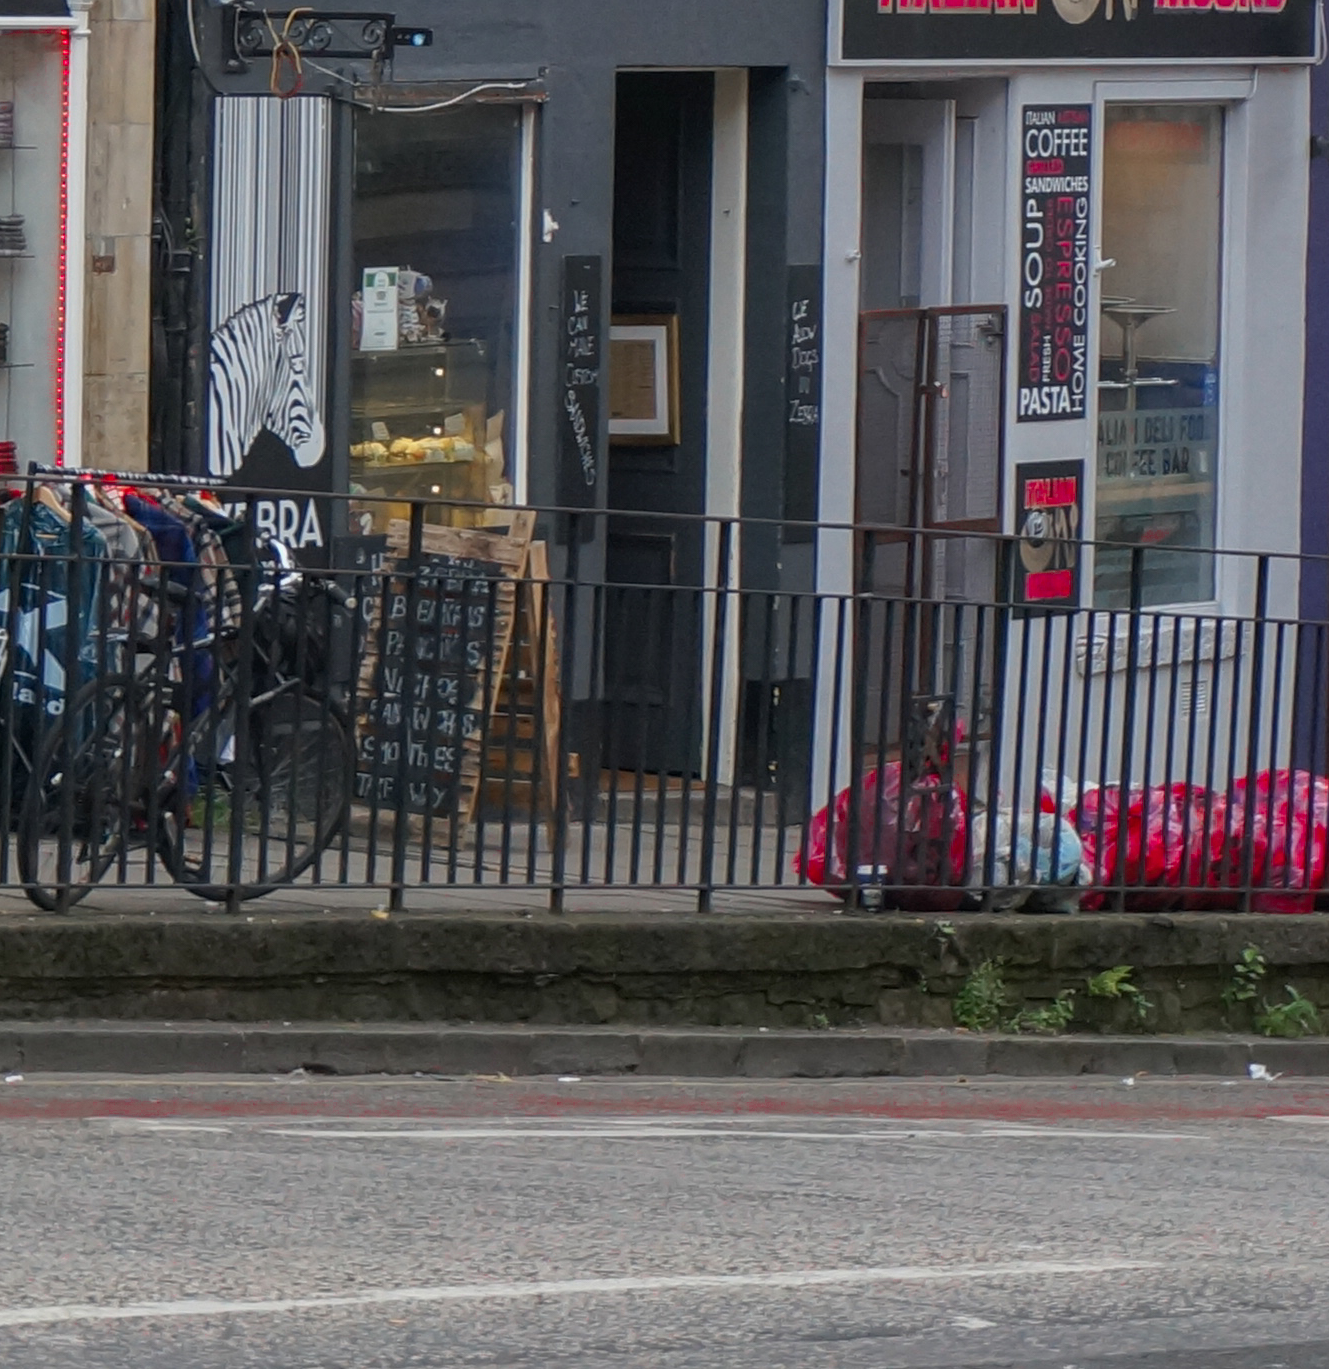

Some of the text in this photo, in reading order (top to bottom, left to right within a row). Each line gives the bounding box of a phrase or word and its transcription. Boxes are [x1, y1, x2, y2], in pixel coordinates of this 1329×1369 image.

[1025, 111, 1056, 125] ITALIAN
[1025, 128, 1088, 158] COFFEE
[1025, 176, 1088, 193] SANDWICHES
[1025, 198, 1043, 309] SOUP
[1054, 197, 1074, 381] ESPRESSO
[1072, 197, 1089, 412] HOME COOKING
[1020, 386, 1072, 416] PASTA
